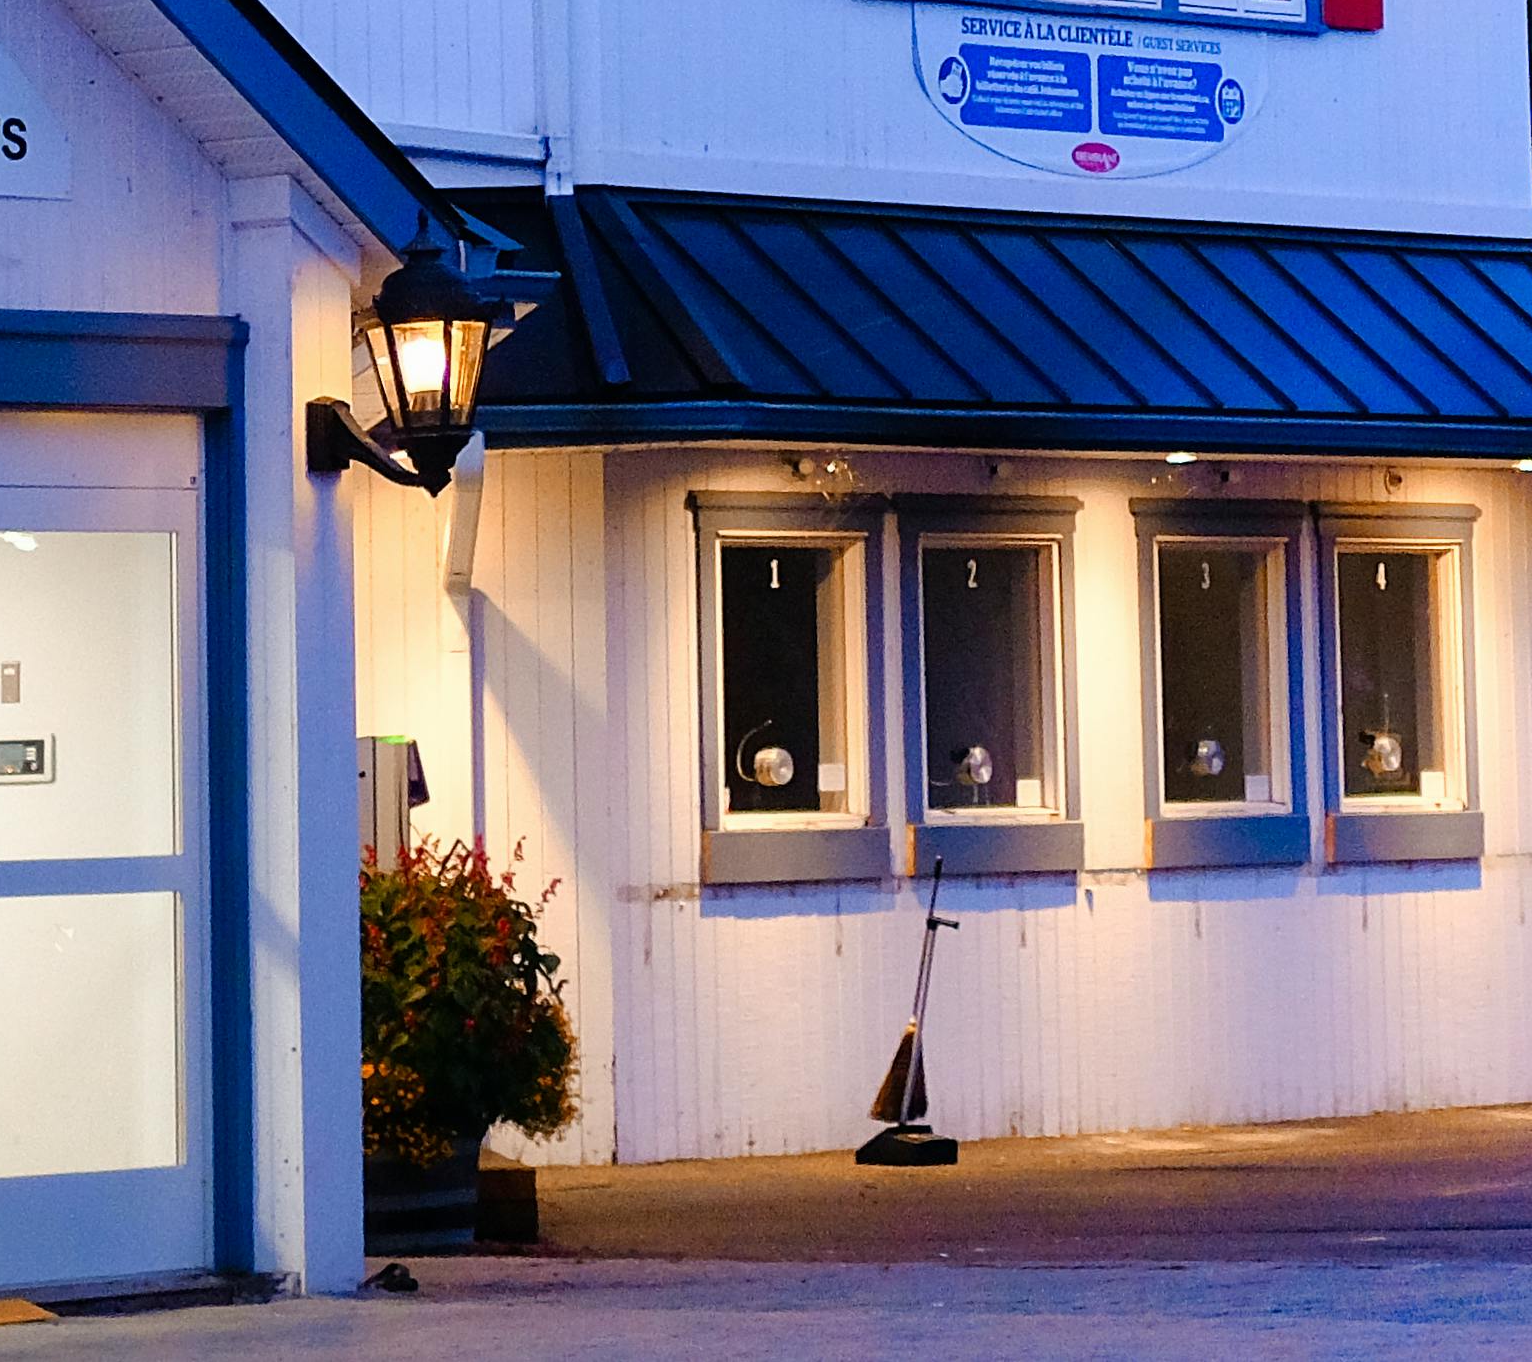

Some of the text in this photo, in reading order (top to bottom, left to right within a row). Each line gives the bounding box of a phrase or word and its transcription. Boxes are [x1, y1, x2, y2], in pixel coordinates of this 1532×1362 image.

[961, 16, 1022, 39] SERVICE
[1024, 18, 1034, 40] À
[1037, 23, 1055, 41] LA
[1058, 25, 1133, 47] CLIENTÈLE
[1142, 36, 1173, 51] GUEST
[1176, 39, 1221, 55] SERVICES
[770, 559, 780, 589] 1
[967, 559, 978, 588] 2
[1201, 562, 1210, 589] 3
[1376, 562, 1387, 590] 4
